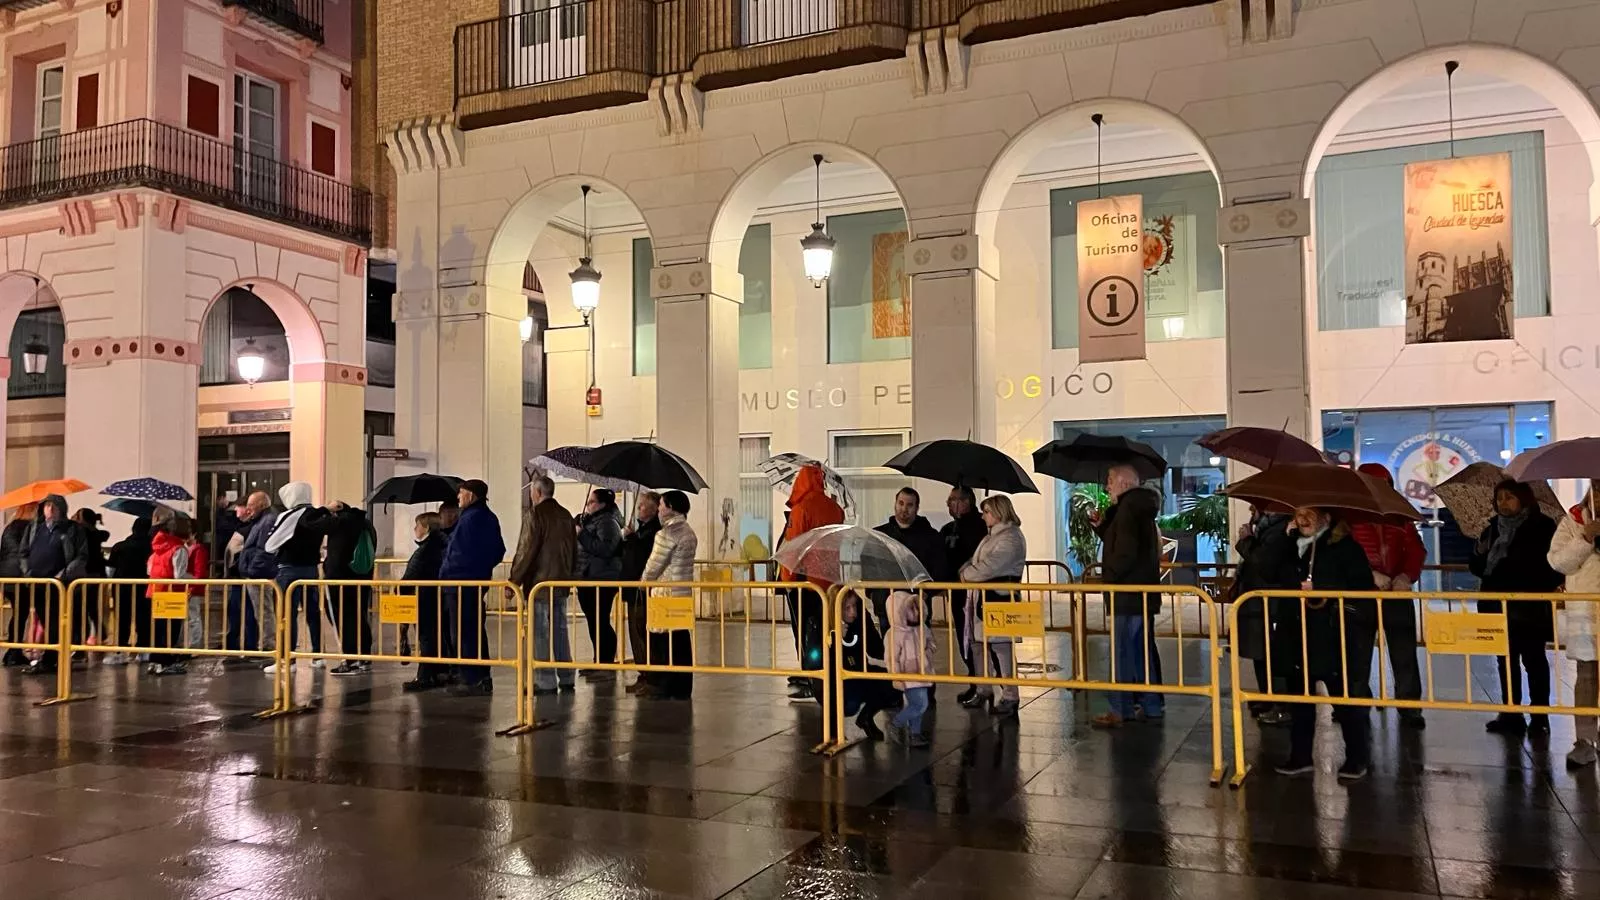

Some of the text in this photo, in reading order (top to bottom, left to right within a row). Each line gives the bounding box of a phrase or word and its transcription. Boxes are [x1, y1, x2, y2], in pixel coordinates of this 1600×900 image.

[1452, 191, 1504, 213] HUESCA
[1091, 213, 1137, 227] Oficina
[1121, 227, 1138, 239] de
[1085, 243, 1138, 257] Turismo
[741, 387, 847, 411] MUSEO
